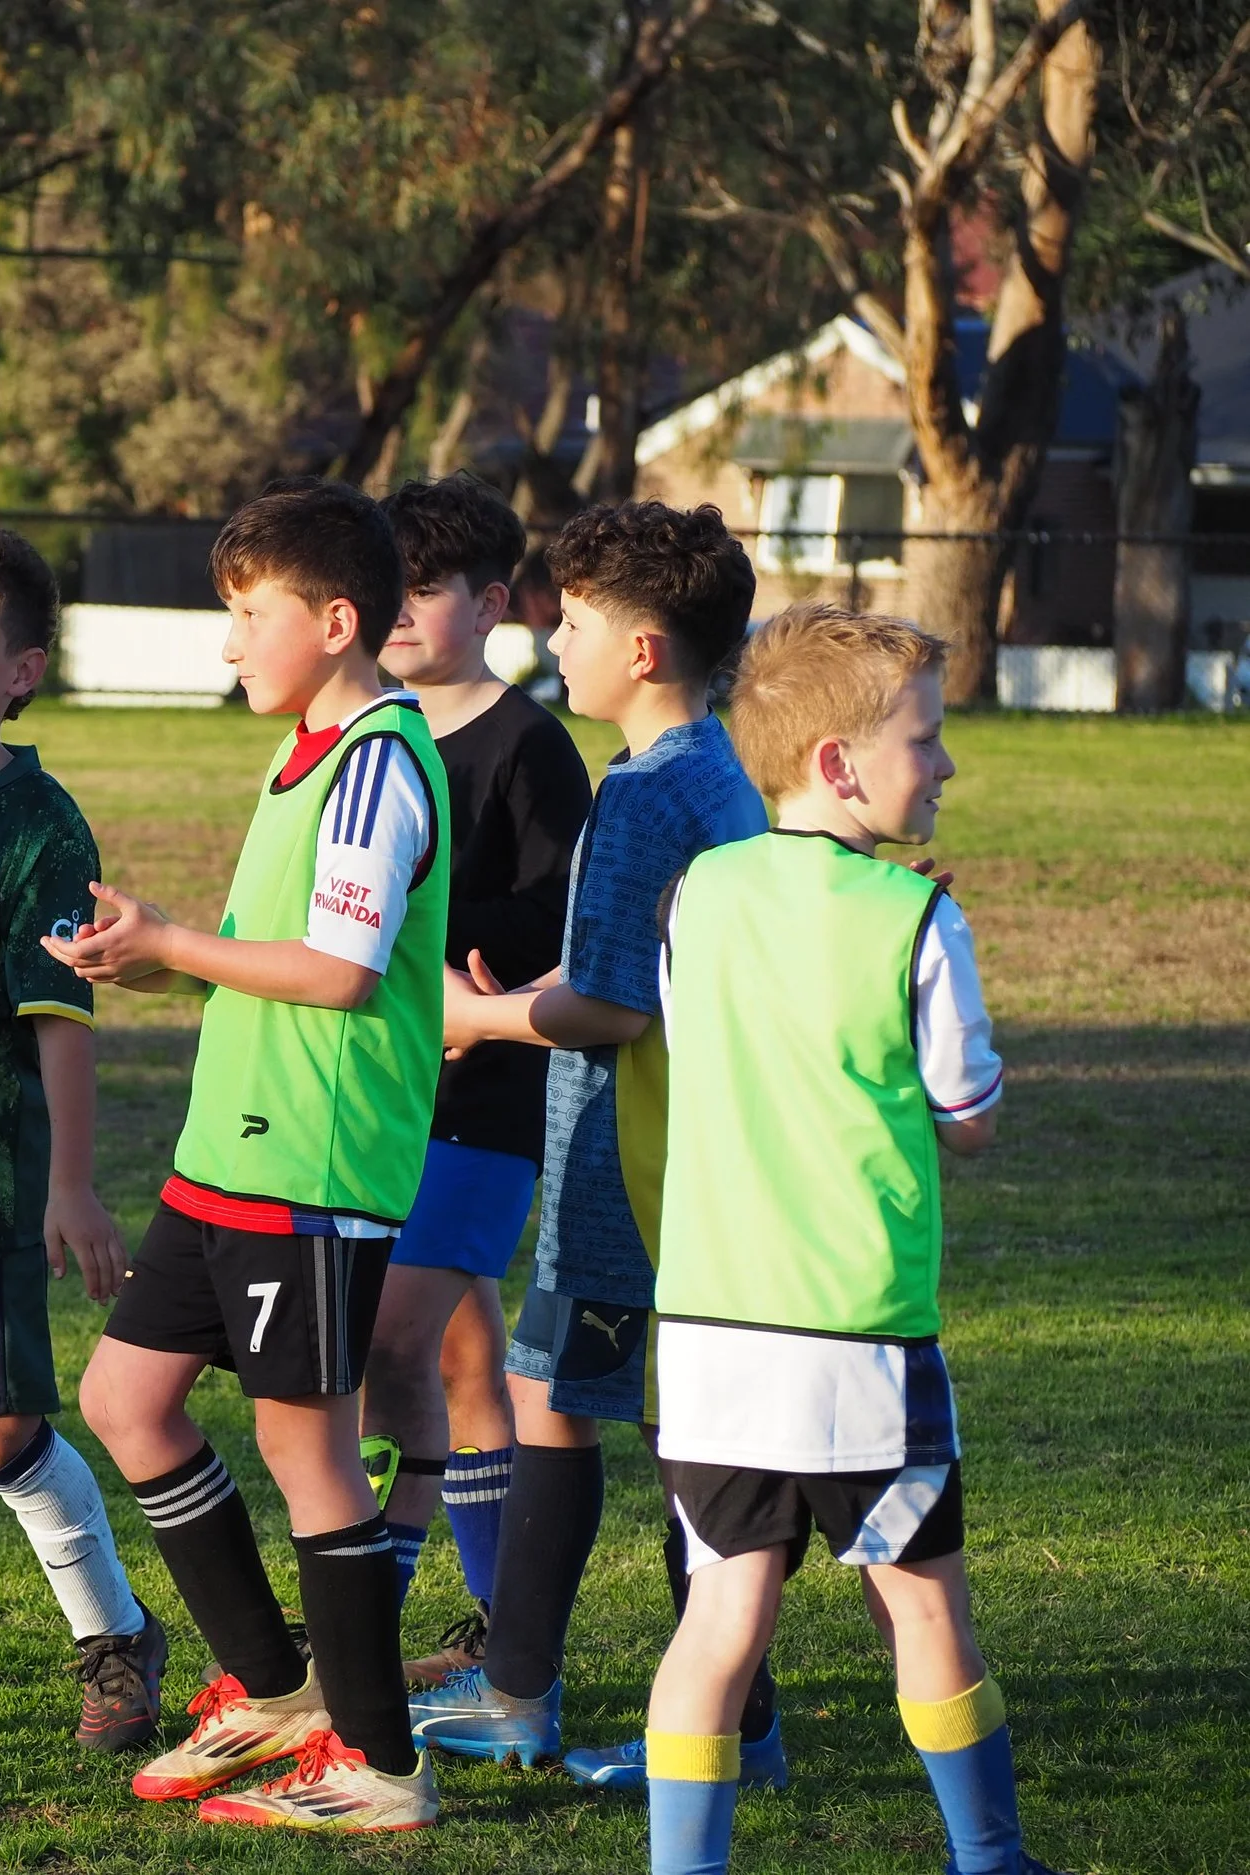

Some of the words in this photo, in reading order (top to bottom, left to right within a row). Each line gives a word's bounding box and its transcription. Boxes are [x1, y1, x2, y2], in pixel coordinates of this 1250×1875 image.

[331, 876, 371, 903] VISIT
[315, 892, 380, 929] RWANDA
[247, 1281, 282, 1353] 7
